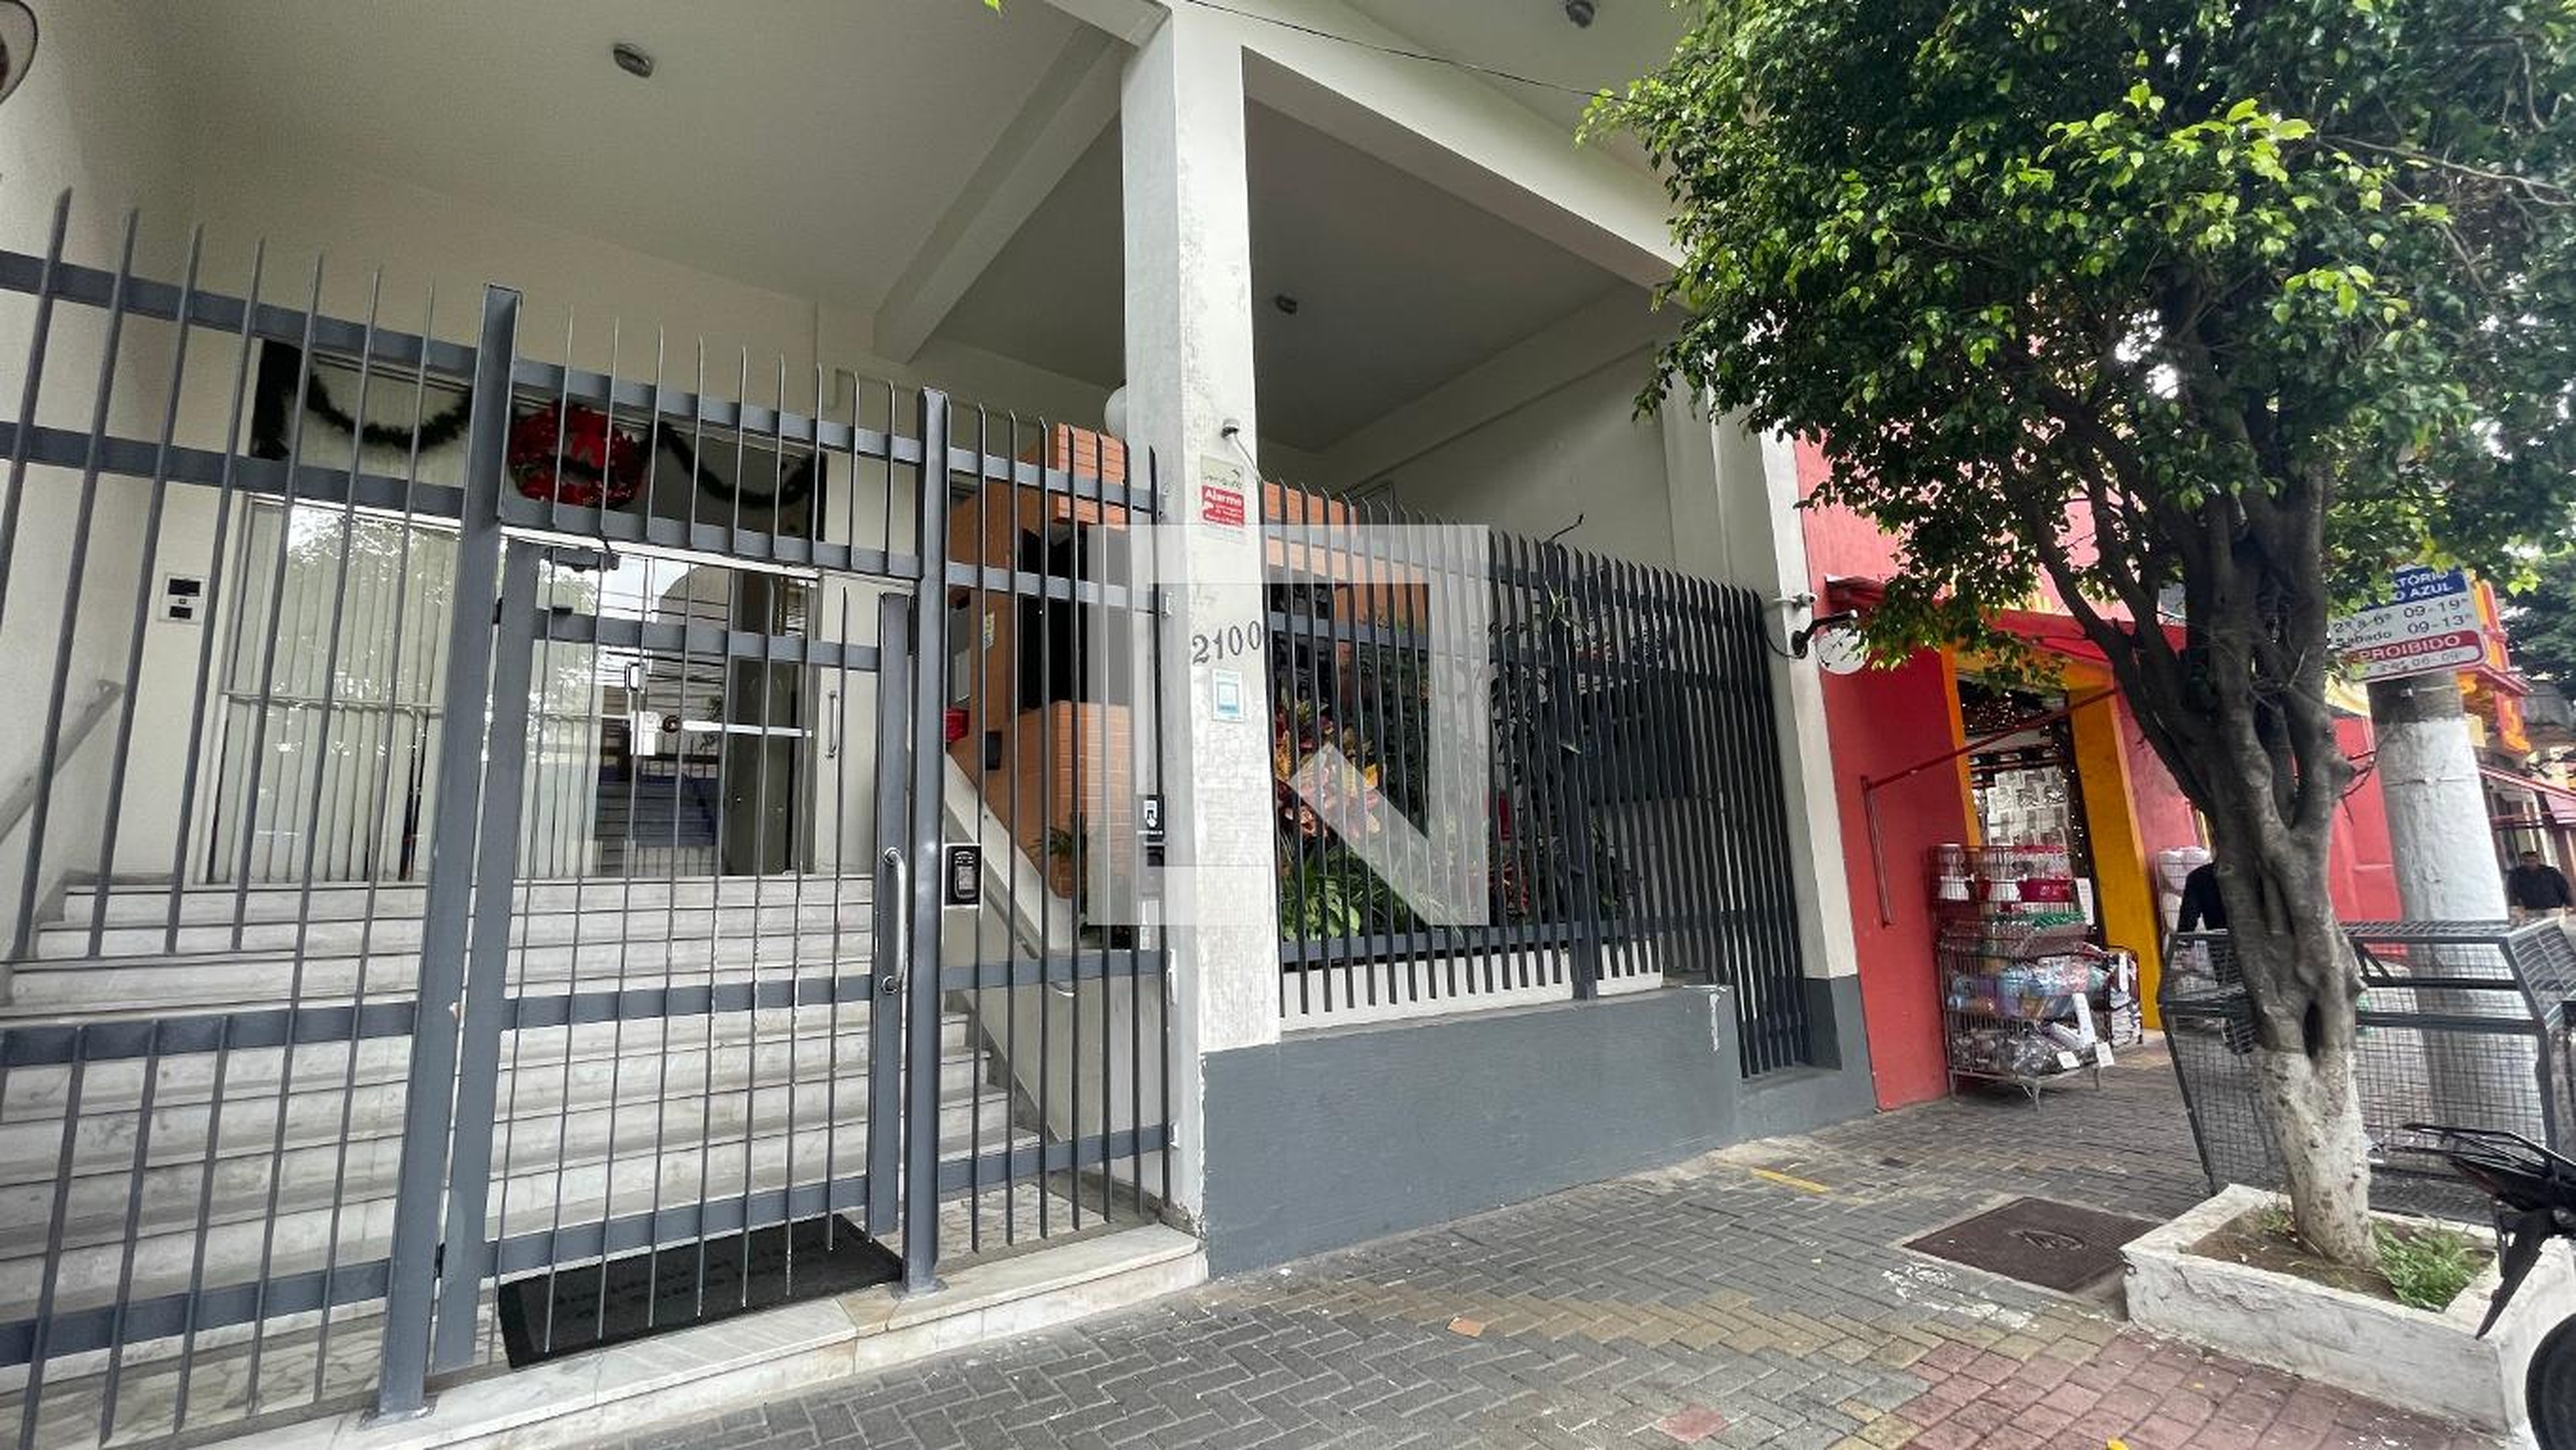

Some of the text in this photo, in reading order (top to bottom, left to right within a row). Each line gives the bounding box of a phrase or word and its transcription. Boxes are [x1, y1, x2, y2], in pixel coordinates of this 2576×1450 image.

[2410, 582, 2453, 597] AZUL
[1192, 621, 1262, 665] 2100
[2358, 635, 2460, 660] PROIBIDO
